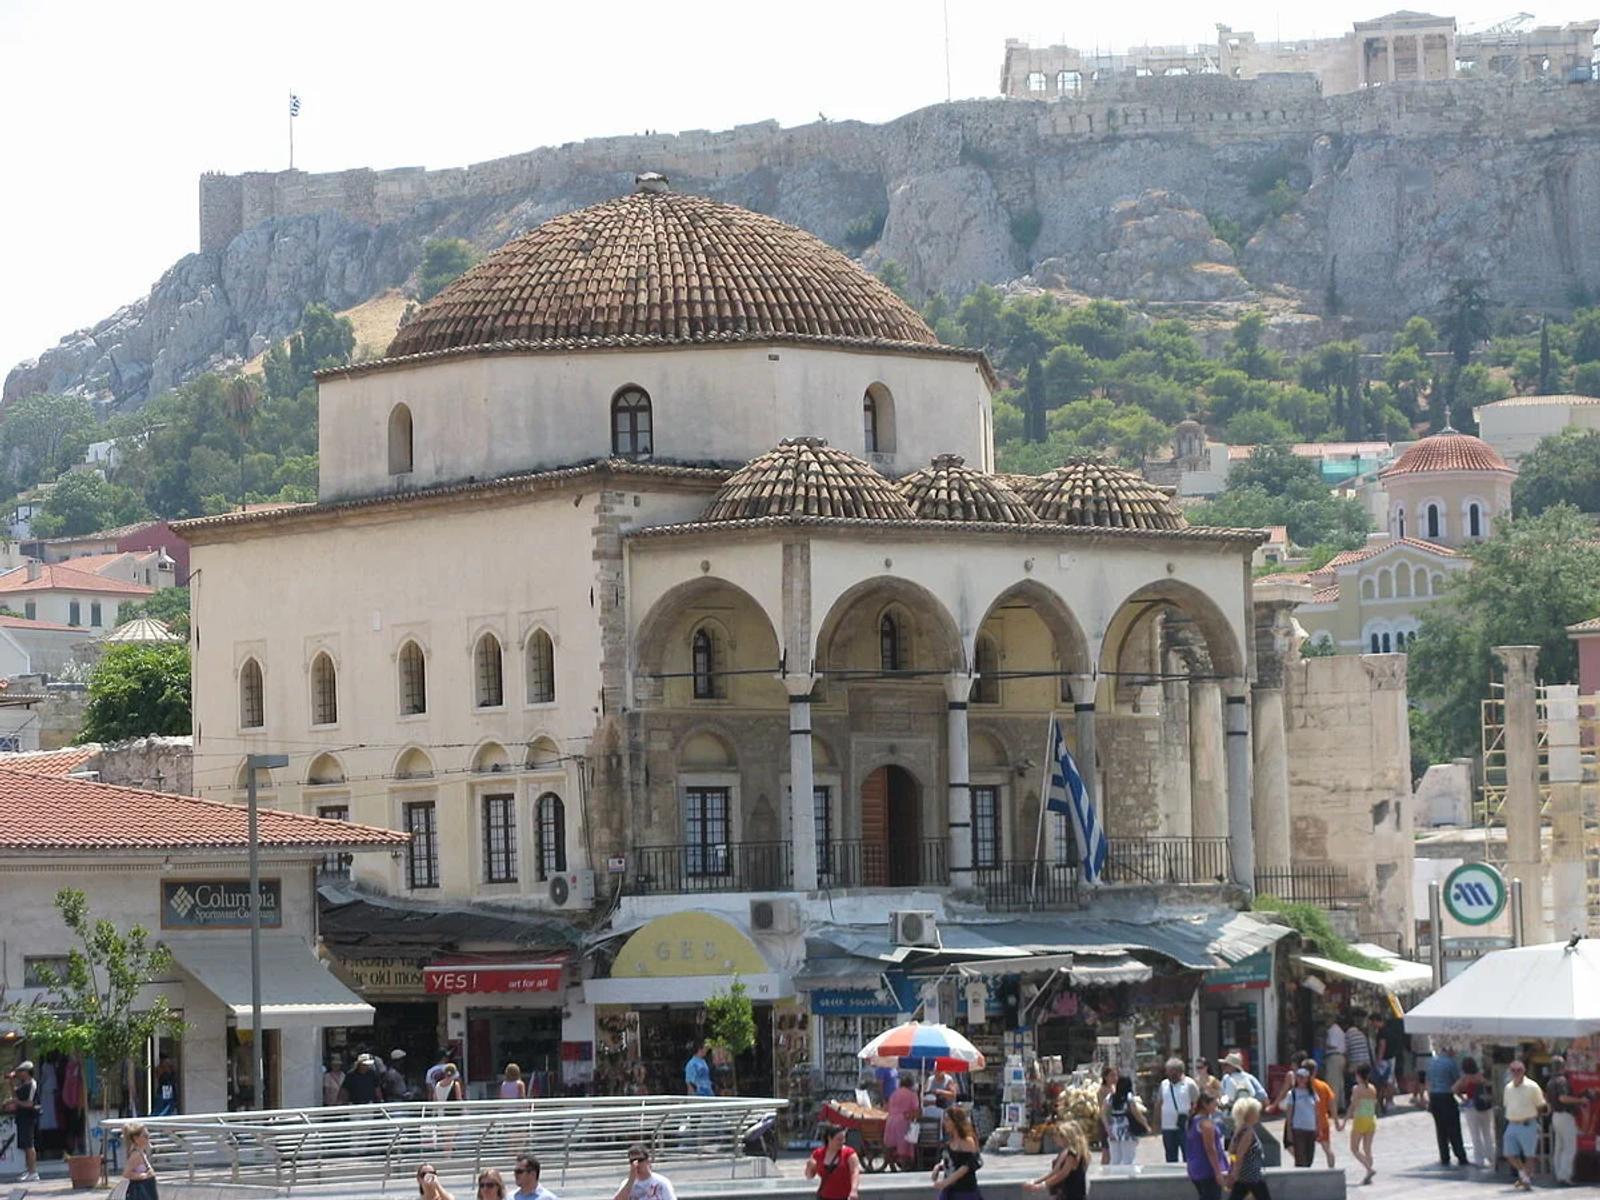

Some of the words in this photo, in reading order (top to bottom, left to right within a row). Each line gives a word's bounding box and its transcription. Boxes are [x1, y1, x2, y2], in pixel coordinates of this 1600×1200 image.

[370, 969, 391, 985] old
[508, 979, 521, 988] art
[522, 978, 535, 988] for
[536, 978, 549, 988] all
